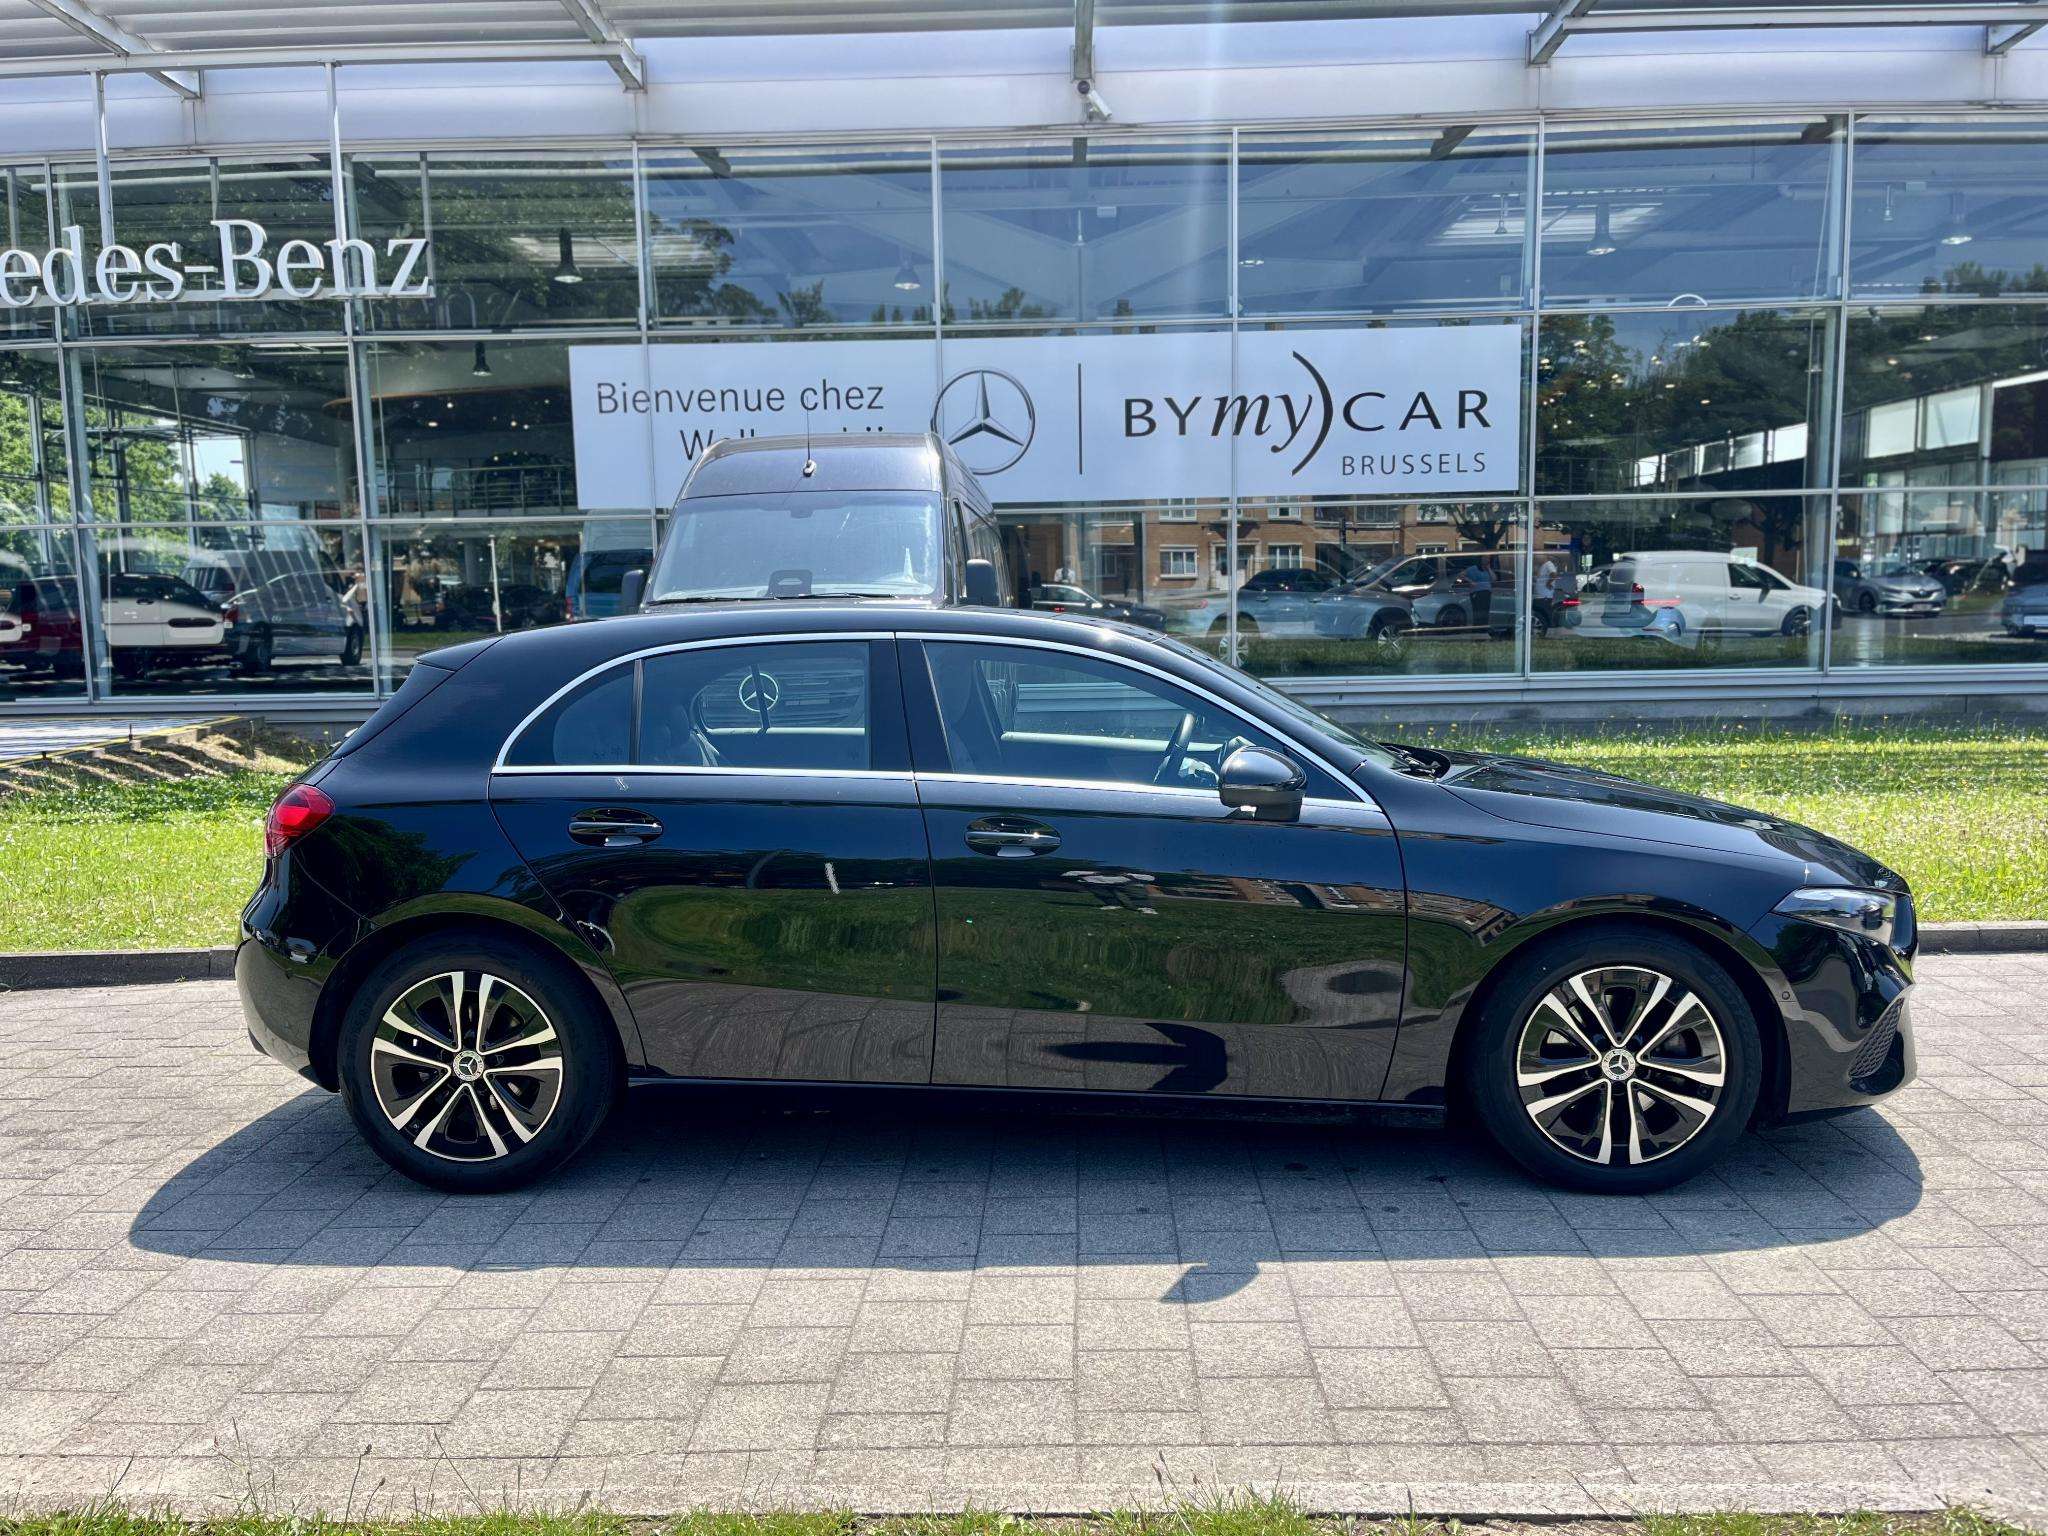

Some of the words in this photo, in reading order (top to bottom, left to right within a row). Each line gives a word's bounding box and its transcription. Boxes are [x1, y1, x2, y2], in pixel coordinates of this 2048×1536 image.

[596, 381, 786, 414] Bienvenue
[800, 378, 885, 412] chez
[1341, 452, 1487, 476] BRUSSELS
